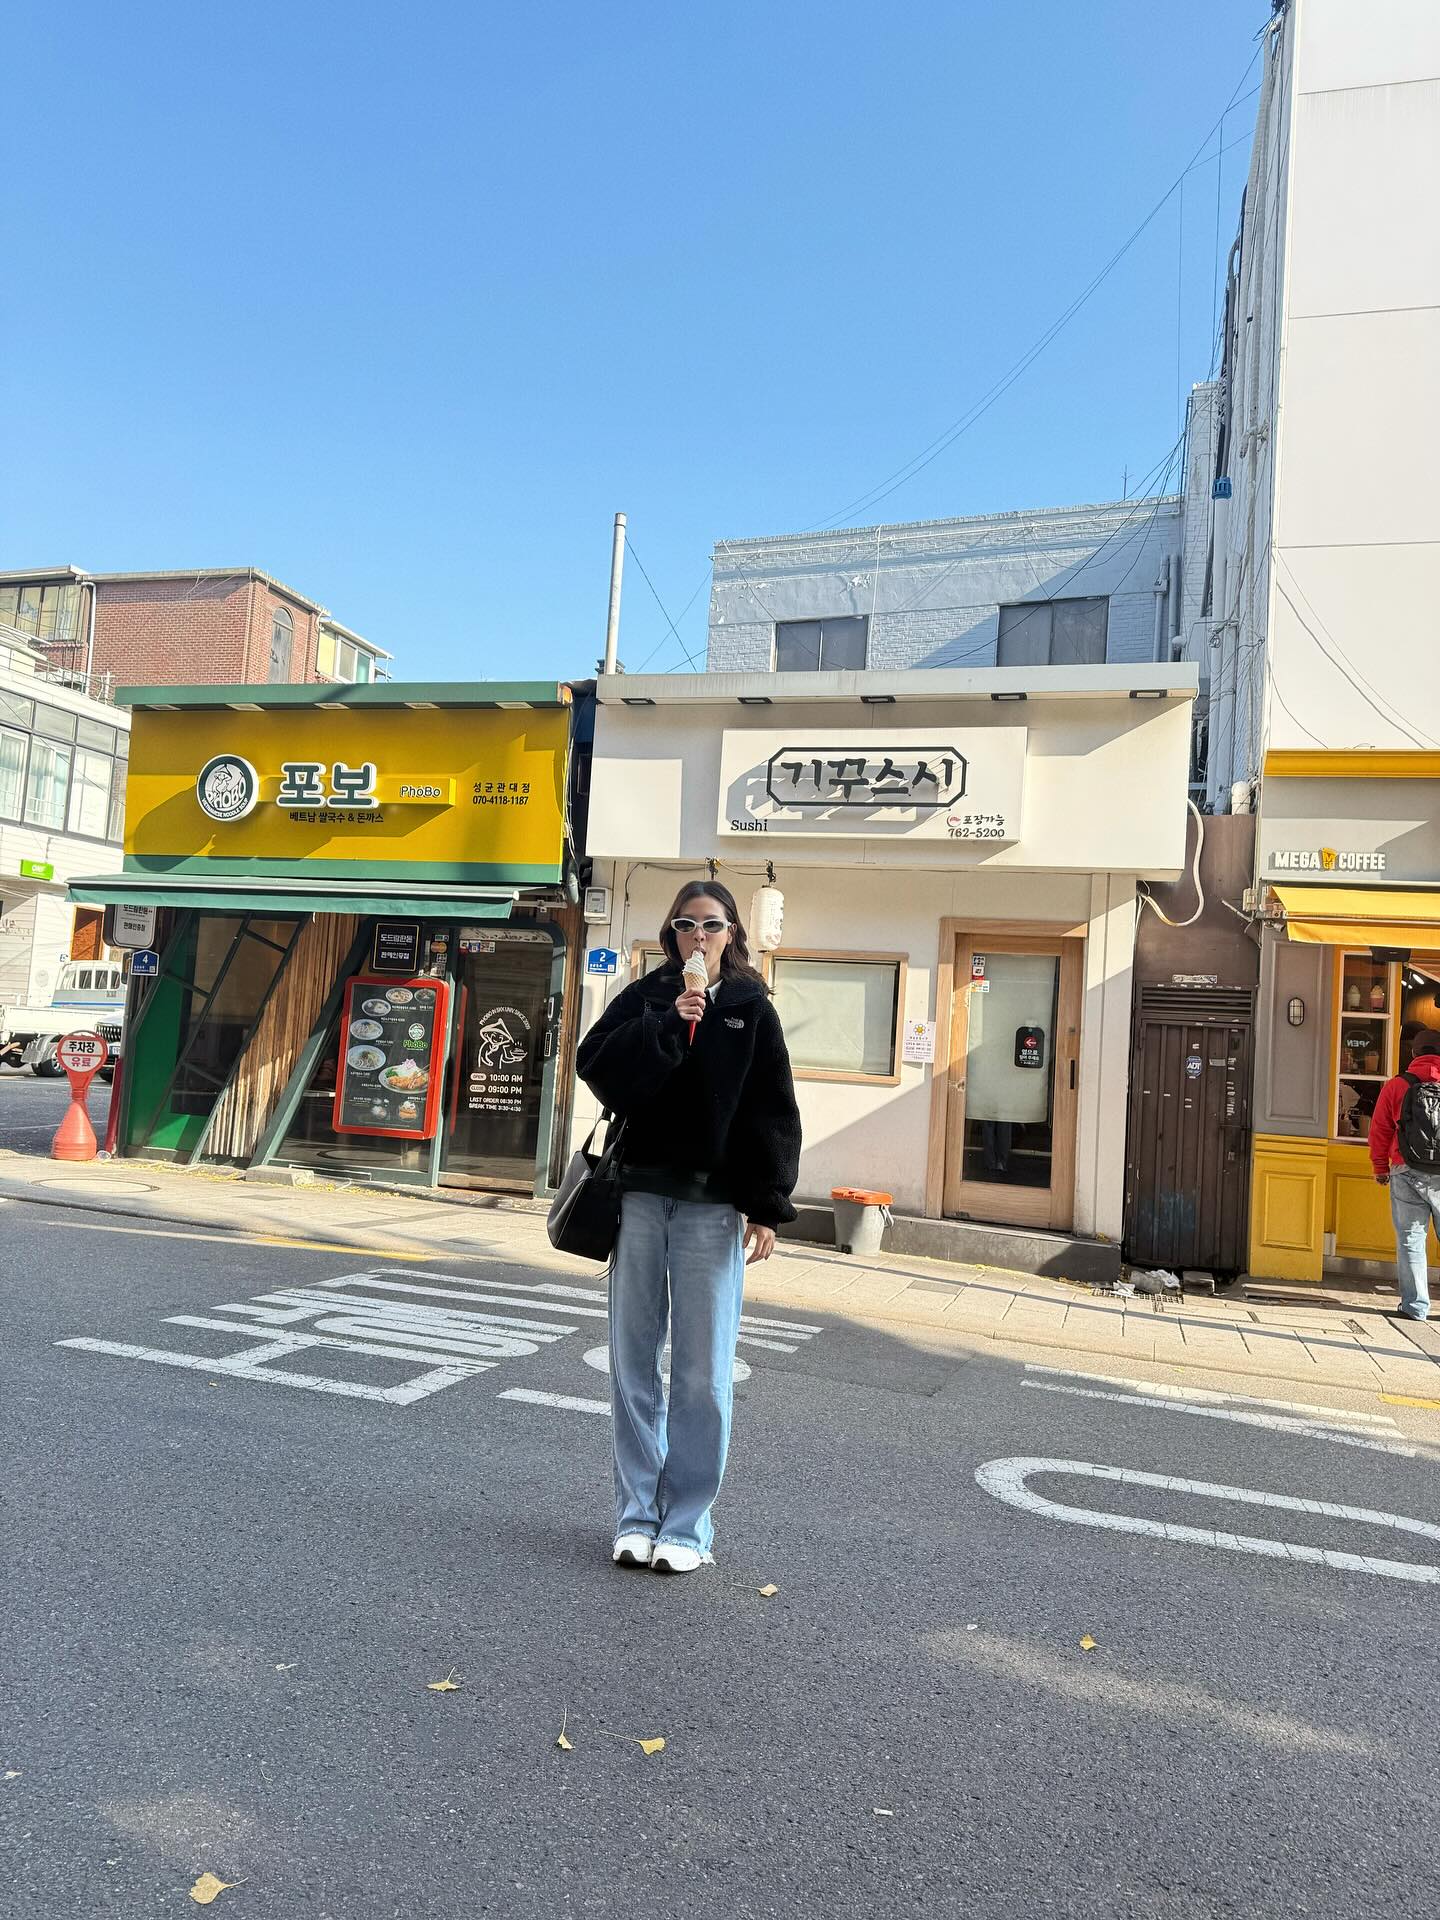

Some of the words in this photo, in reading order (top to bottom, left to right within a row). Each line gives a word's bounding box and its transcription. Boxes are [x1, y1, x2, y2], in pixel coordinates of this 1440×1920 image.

[780, 757, 955, 801] 기꾸스시
[277, 762, 380, 809] 포보
[472, 795, 529, 806] 070-4118-1187
[290, 811, 316, 824] 베트남
[319, 811, 345, 824] 쌀국수
[348, 814, 355, 825] &
[357, 812, 384, 825] 돈까스
[962, 814, 1005, 826] 포장가능
[730, 818, 768, 832] Sushi
[948, 827, 1005, 838] 762-5200
[1275, 851, 1320, 869] MEGA
[1338, 852, 1386, 870] COFFEE
[142, 953, 149, 964] 4
[599, 951, 606, 962] 2
[68, 1040, 96, 1054] 주차장
[71, 1056, 91, 1067] 유료
[1186, 1062, 1201, 1070] ADT
[489, 1074, 510, 1082] 10:00
[511, 1074, 523, 1083] AM
[487, 1085, 509, 1094] 09:00
[510, 1086, 522, 1095] PM
[468, 1102, 485, 1110] BREAK
